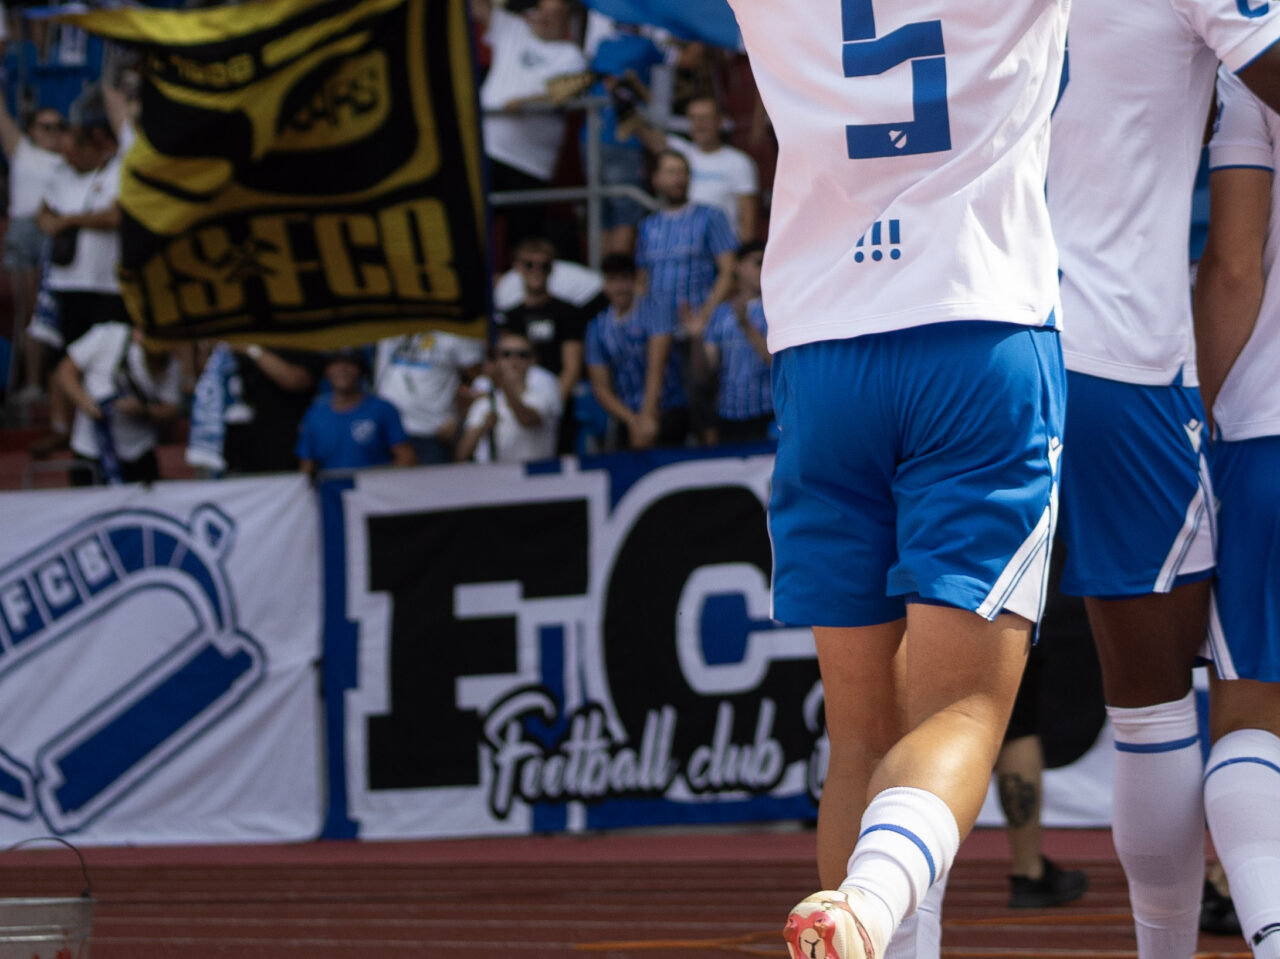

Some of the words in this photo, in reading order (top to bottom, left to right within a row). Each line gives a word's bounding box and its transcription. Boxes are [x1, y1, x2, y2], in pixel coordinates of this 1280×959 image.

[1, 538, 112, 633] FCB
[366, 484, 826, 800] FC
[483, 690, 680, 815] Football
[687, 697, 785, 789] club
